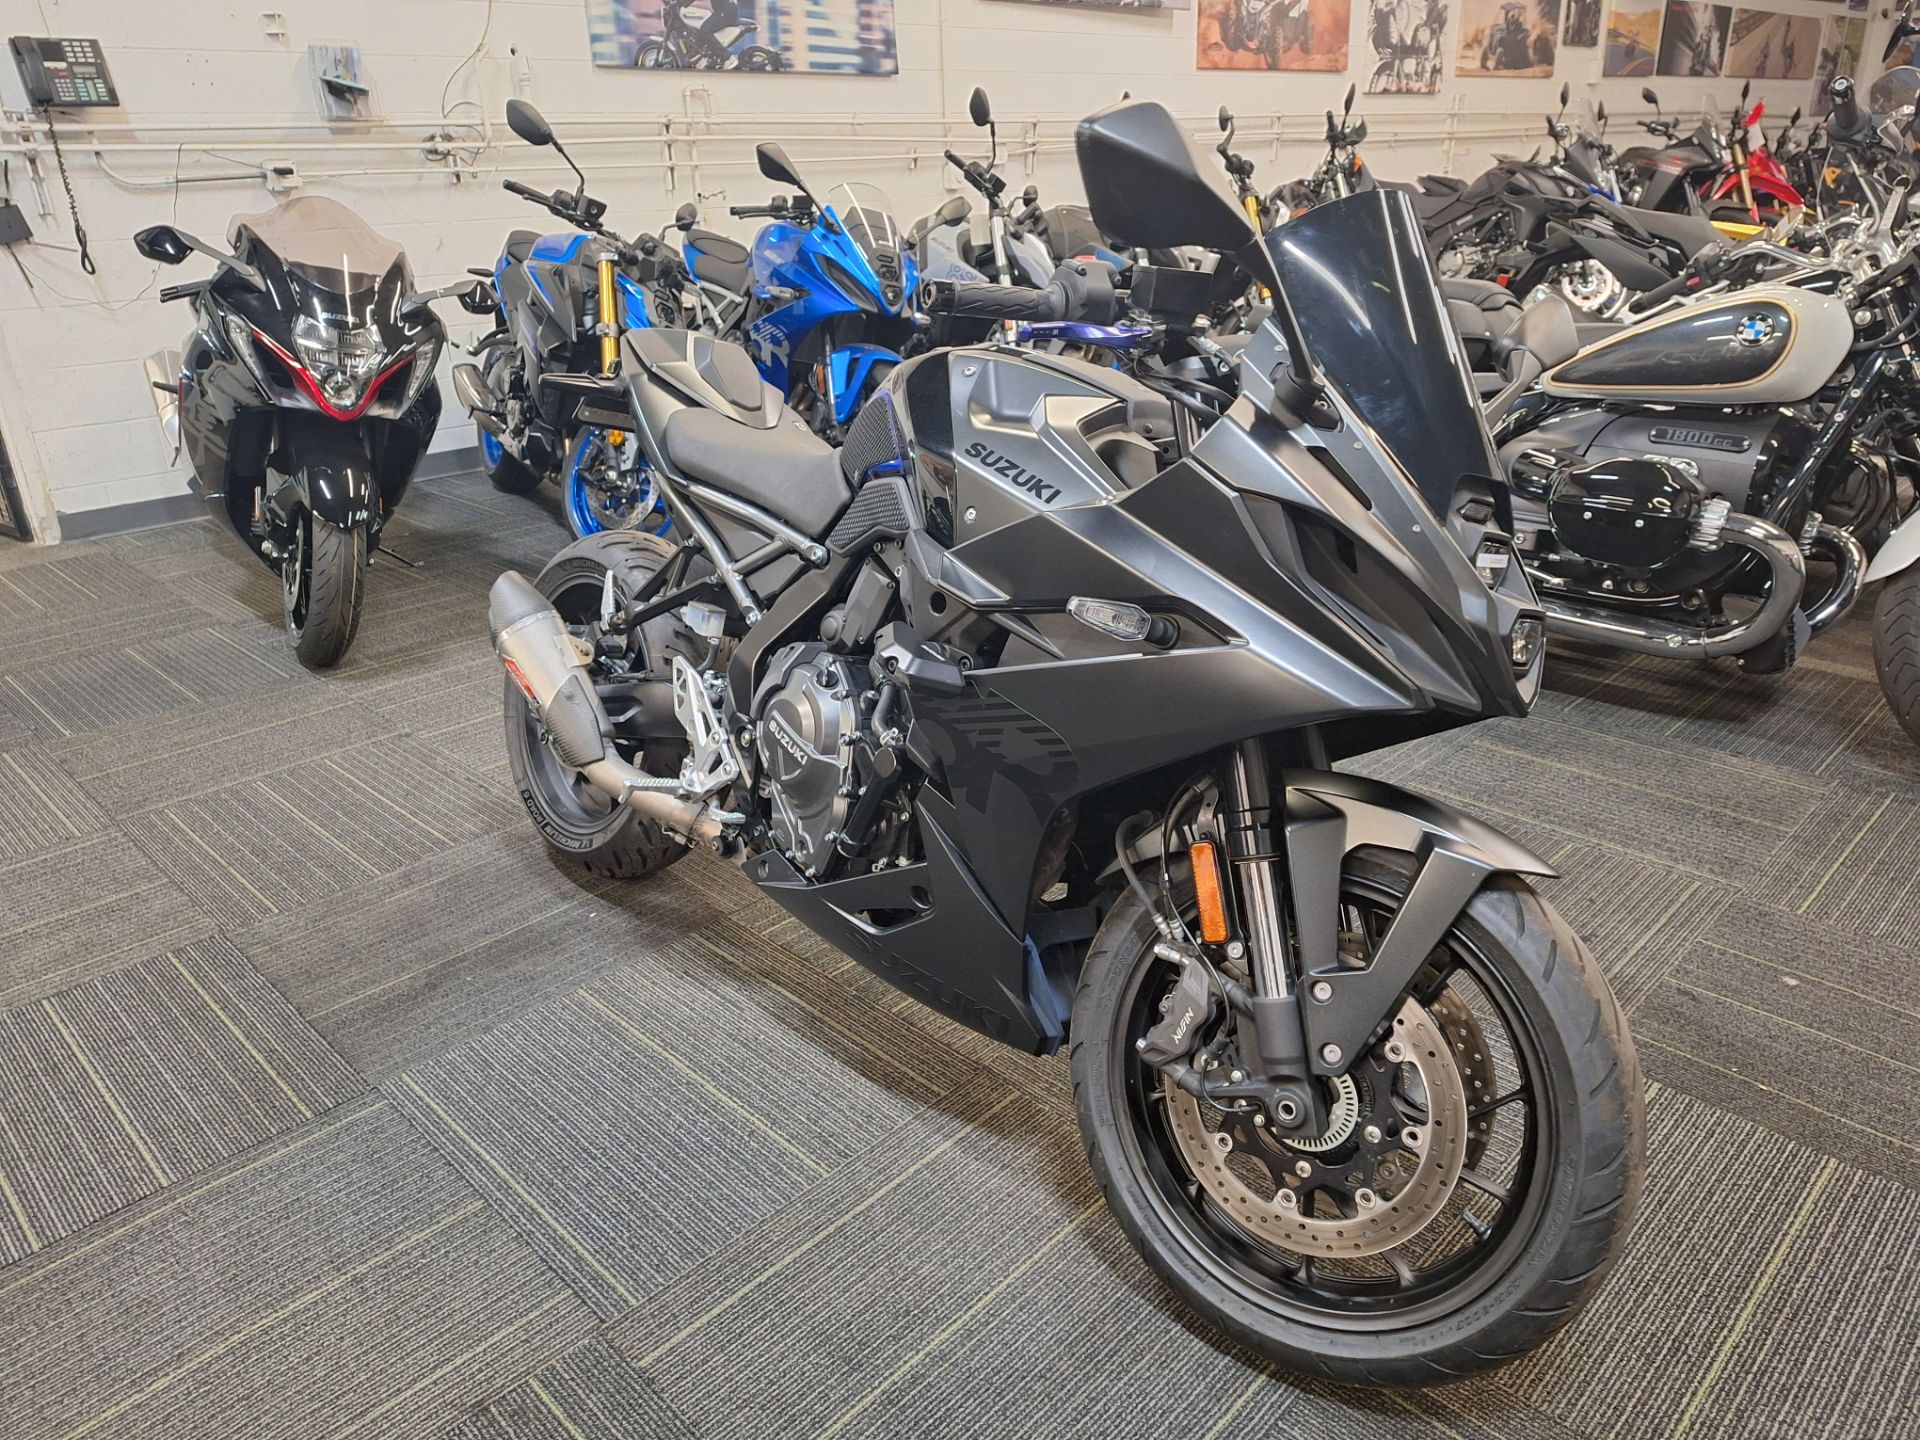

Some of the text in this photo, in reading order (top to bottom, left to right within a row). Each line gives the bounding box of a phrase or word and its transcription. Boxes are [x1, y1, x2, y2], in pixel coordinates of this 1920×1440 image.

[964, 442, 1063, 505] SUZUKI
[768, 719, 808, 766] SUZUKI
[526, 799, 544, 822] ROAD
